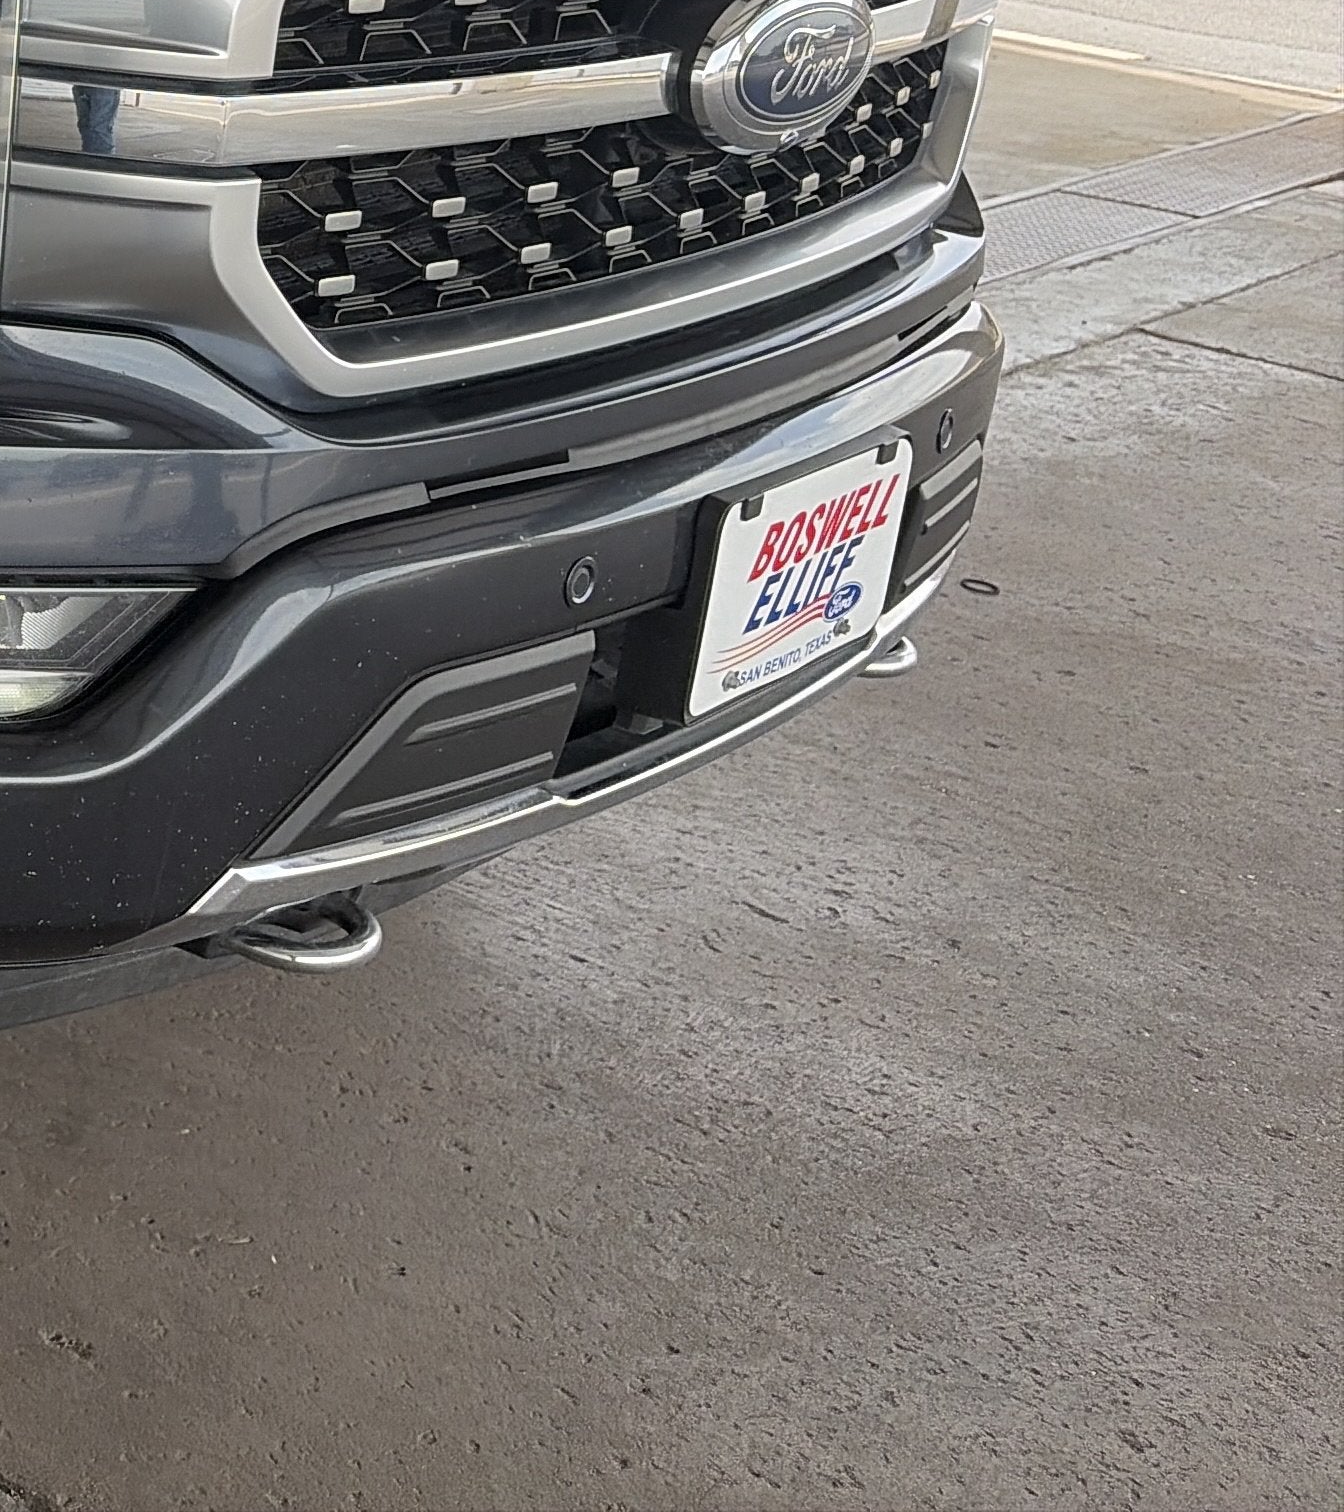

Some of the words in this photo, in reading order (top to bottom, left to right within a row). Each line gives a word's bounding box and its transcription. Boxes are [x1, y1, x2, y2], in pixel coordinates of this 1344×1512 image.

[770, 24, 855, 106] Ford
[747, 472, 901, 584] BOSWELL
[742, 533, 866, 636] ELLIFF
[738, 664, 764, 687] SAN
[763, 648, 803, 677] BENITO,
[805, 629, 833, 657] TEXAS
